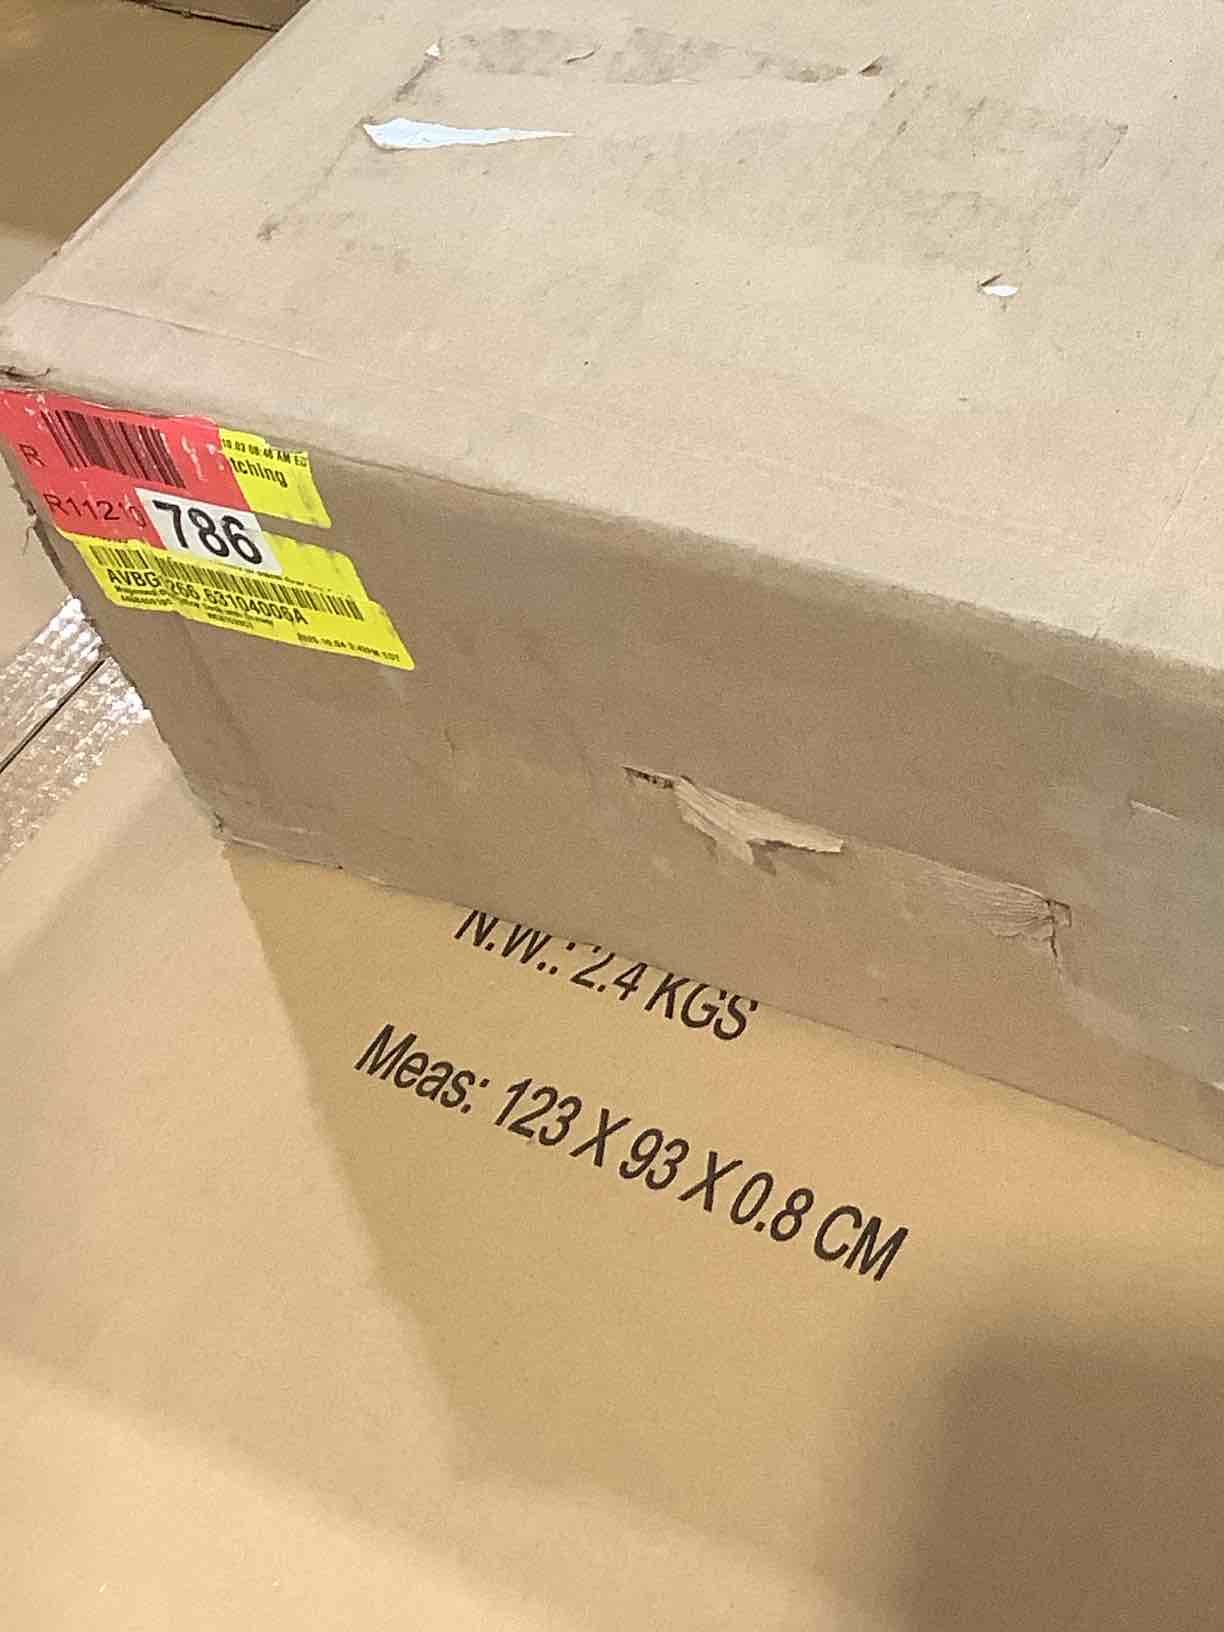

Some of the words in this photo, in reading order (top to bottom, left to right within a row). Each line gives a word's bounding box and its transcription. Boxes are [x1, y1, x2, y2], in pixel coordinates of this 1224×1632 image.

[18, 443, 47, 468] R
[151, 499, 264, 565] 786
[569, 943, 649, 1002] 2.4
[644, 971, 759, 1042] KGS
[354, 1023, 492, 1114] Meas:
[492, 1077, 583, 1147] 123
[569, 1108, 631, 1168] X
[618, 1127, 690, 1191] 93
[678, 1151, 744, 1212] X
[729, 1171, 815, 1243] 0.8
[813, 1205, 911, 1283] CM
